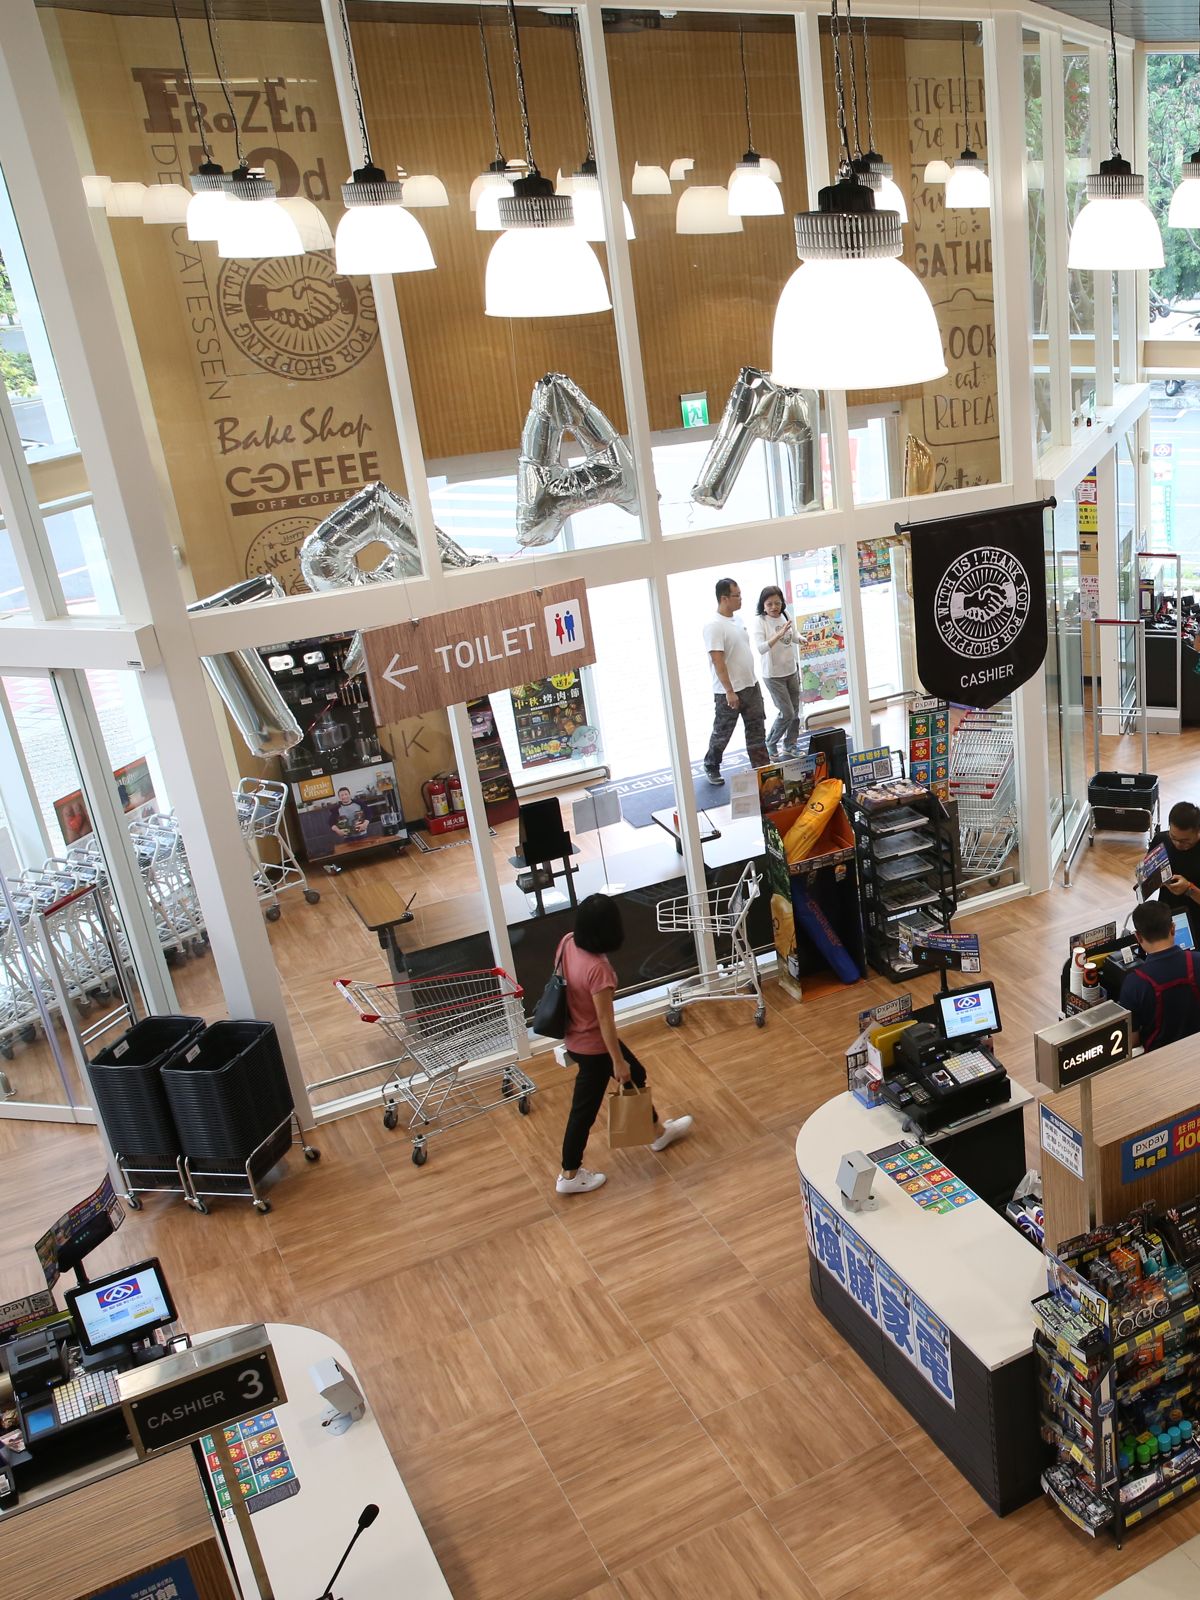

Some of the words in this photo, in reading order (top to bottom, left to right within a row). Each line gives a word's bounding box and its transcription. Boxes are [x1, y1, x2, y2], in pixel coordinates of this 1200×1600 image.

[222, 259, 250, 317] WITH
[233, 322, 337, 376] SHOPPING
[337, 327, 374, 364] FOR
[940, 324, 997, 360] OOK
[955, 361, 982, 390] eat
[214, 414, 296, 455] Bake
[300, 406, 372, 448] Shop
[226, 451, 381, 498] COFFEE
[256, 499, 288, 511] OFF
[981, 550, 1022, 582] THANK
[937, 576, 955, 618] WITH
[1016, 580, 1029, 611] YOU
[941, 621, 999, 656] SHOPPING
[1004, 615, 1024, 643] FOR
[434, 622, 536, 673] TOILET
[960, 663, 1015, 688] CASHIER
[1063, 1044, 1104, 1070] CASHIER
[1110, 1030, 1123, 1056] 2
[1135, 1132, 1166, 1154] pxpay
[146, 1390, 226, 1430] CASHIER
[237, 1369, 265, 1400] 3
